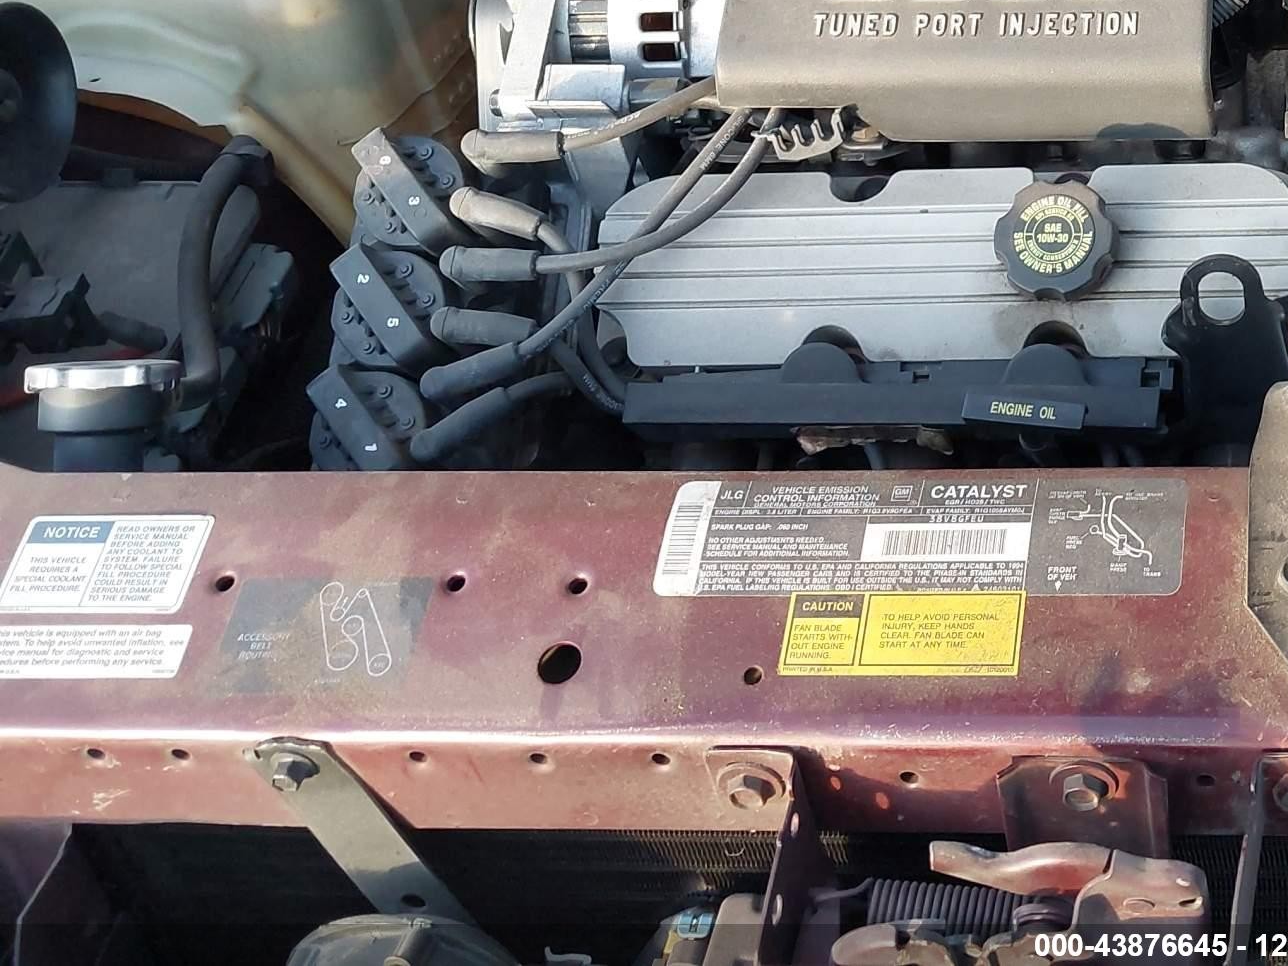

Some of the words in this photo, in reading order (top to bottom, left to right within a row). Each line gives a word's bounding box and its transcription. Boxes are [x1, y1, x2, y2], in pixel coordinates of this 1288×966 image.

[813, 12, 900, 37] TUNED
[915, 12, 984, 37] PORT
[999, 11, 1139, 36] INJECTION
[408, 196, 420, 206] 3
[1020, 195, 1055, 222] ENGINE
[1057, 195, 1072, 208] OIL
[1071, 202, 1089, 223] FILL
[1045, 223, 1062, 232] SAE
[1014, 232, 1025, 252] SEE
[1036, 233, 1069, 243] 10W-30
[1063, 231, 1093, 270] MANUAL
[1019, 251, 1063, 274] OWNER'S
[357, 273, 370, 284] 2
[386, 317, 399, 328] 5
[335, 398, 347, 409] 4
[990, 402, 1034, 417] ENGINE
[1039, 406, 1056, 420] OIL
[721, 490, 744, 500] JLG
[772, 486, 817, 495] VEHICLE
[818, 485, 869, 494] EMISSION
[931, 484, 1028, 499] CATALYST
[754, 494, 805, 503] CONTROL
[806, 493, 880, 503] INFORMATION
[43, 526, 101, 539] NOTICE
[1047, 566, 1077, 574] FRONT
[1047, 573, 1059, 581] OF
[802, 601, 854, 611] CAUTION
[881, 623, 916, 631] INJURY,
[55, 630, 96, 638] equipped
[98, 629, 117, 637] with
[132, 629, 143, 637] air
[146, 629, 163, 638] bag
[25, 639, 34, 647] To
[37, 639, 55, 648] help
[58, 639, 82, 647] avoid
[84, 639, 127, 647] unwanted
[250, 642, 272, 650] BELT
[879, 641, 907, 649] START
[910, 641, 921, 649] AT
[924, 641, 942, 649] ANY
[66, 648, 111, 657] diagnostic
[133, 648, 164, 656] service
[61, 658, 110, 667] performing
